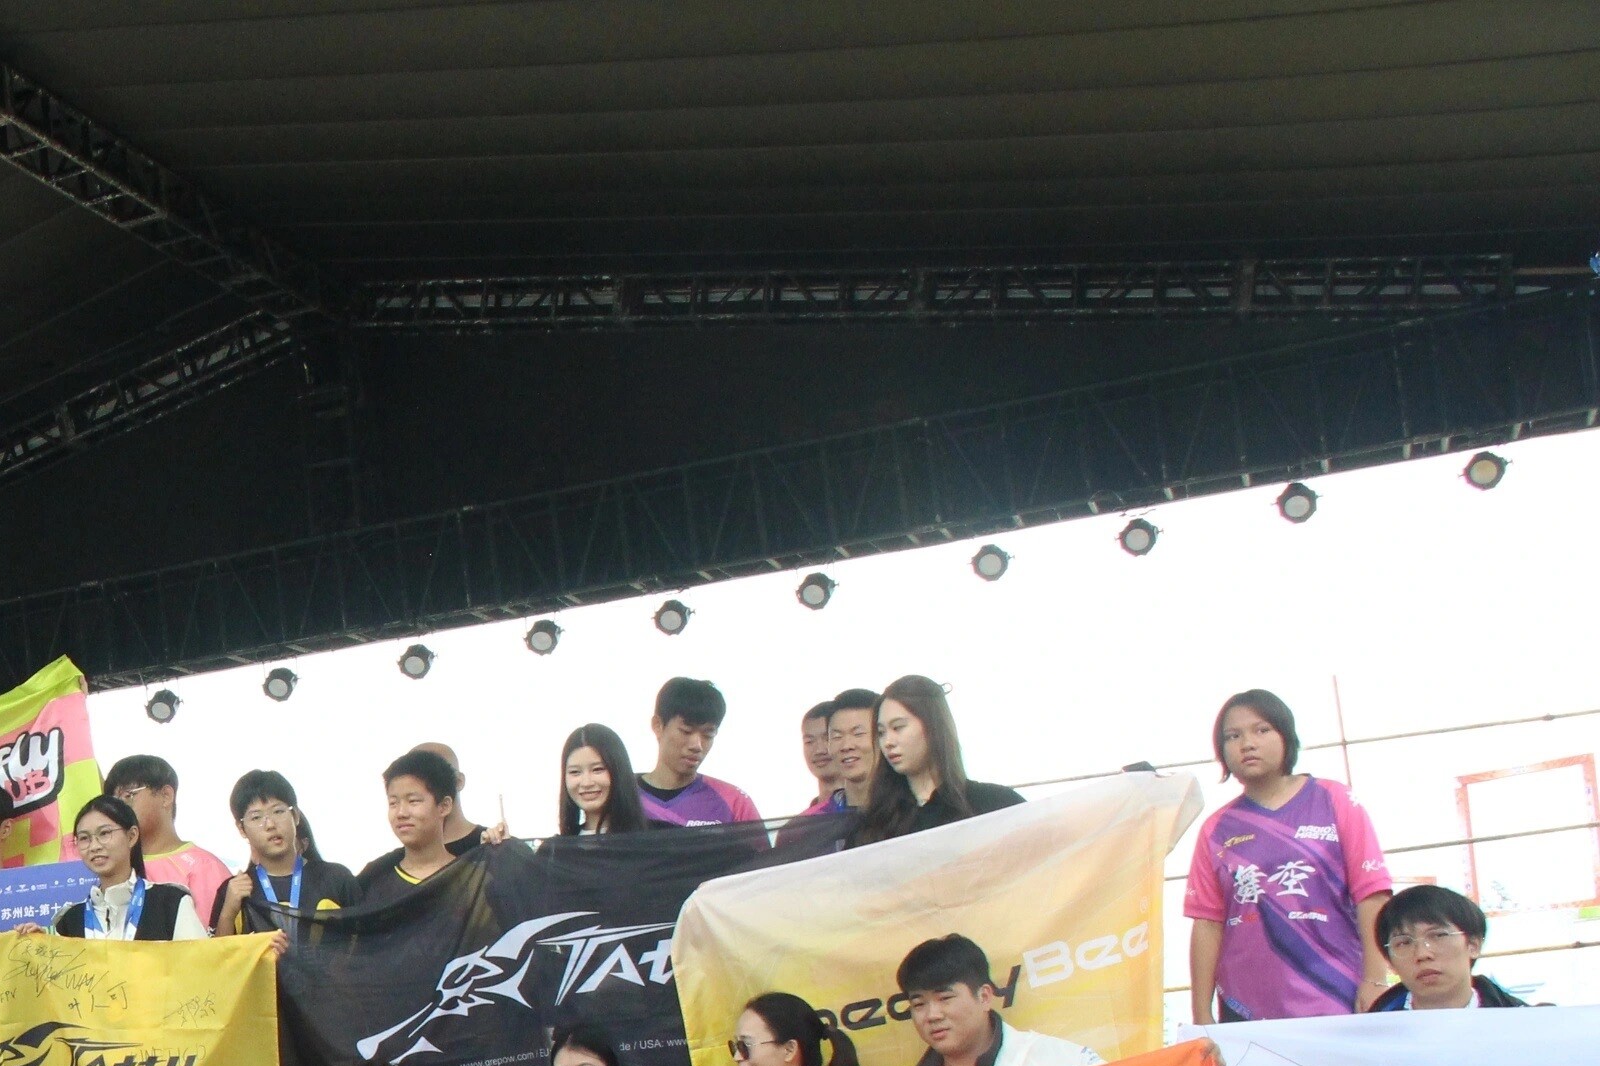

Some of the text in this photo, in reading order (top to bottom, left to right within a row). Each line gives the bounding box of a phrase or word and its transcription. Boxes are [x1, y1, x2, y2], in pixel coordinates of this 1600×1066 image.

[1, 900, 72, 920] 苏州站-第十
